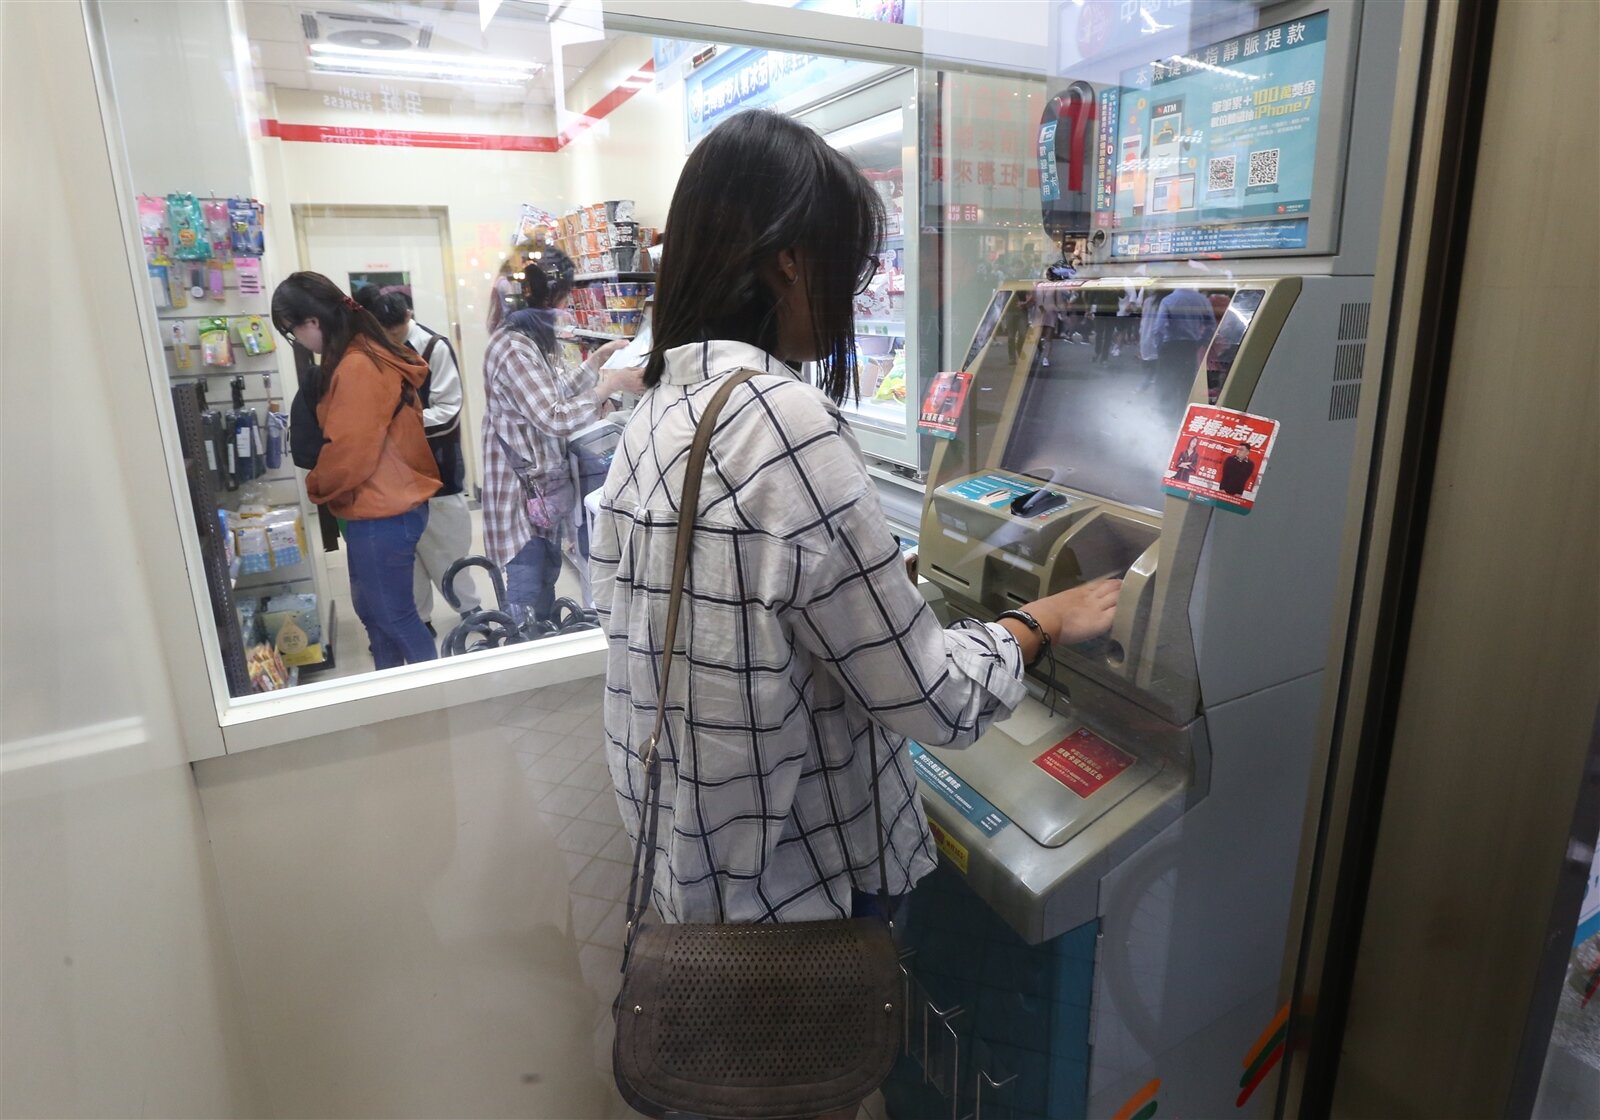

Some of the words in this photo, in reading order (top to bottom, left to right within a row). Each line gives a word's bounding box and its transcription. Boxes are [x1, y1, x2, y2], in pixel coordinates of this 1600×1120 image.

[1163, 103, 1177, 115] ATM
[1188, 415, 1268, 448] 春嬌救志明
